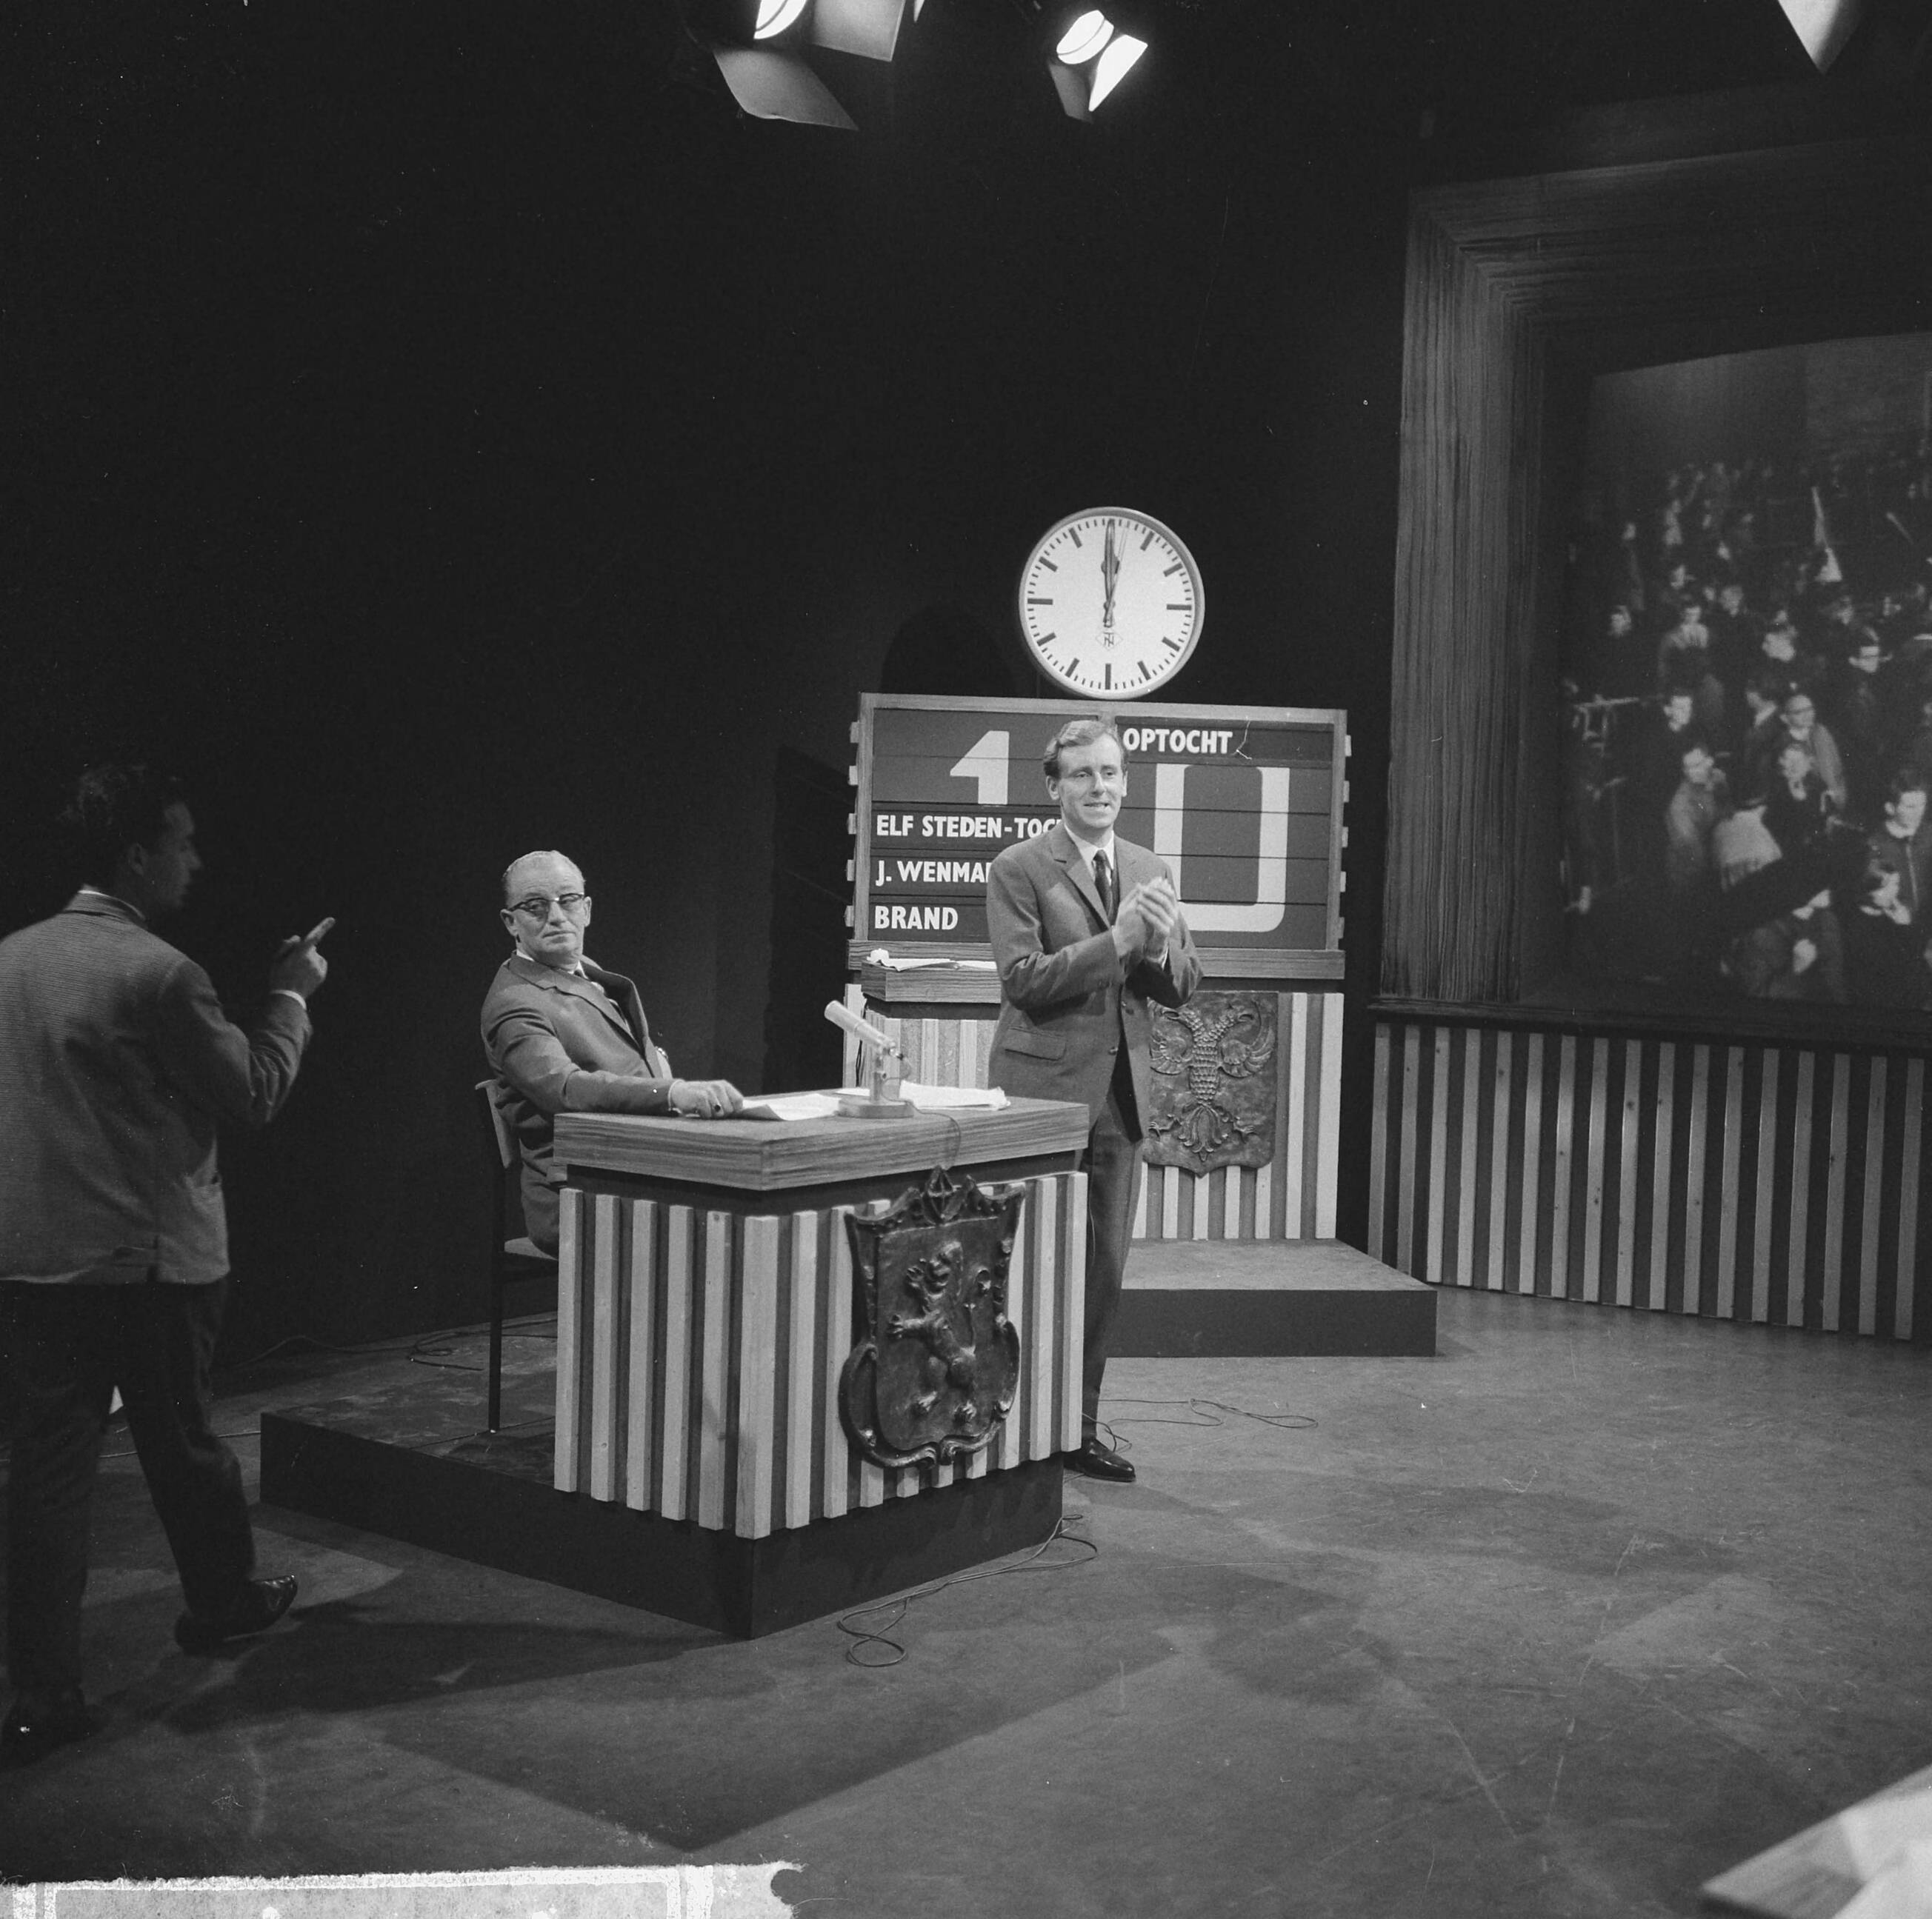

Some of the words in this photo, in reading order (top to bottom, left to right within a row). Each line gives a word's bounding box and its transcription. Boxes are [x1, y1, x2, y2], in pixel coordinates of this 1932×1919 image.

[1122, 727, 1233, 754] OPTOCHT
[876, 815, 914, 836] ELF
[922, 815, 1062, 838] STEDEN-TOC
[875, 860, 892, 887] J.
[897, 861, 993, 883] WENMA
[874, 905, 959, 930] BRAND
